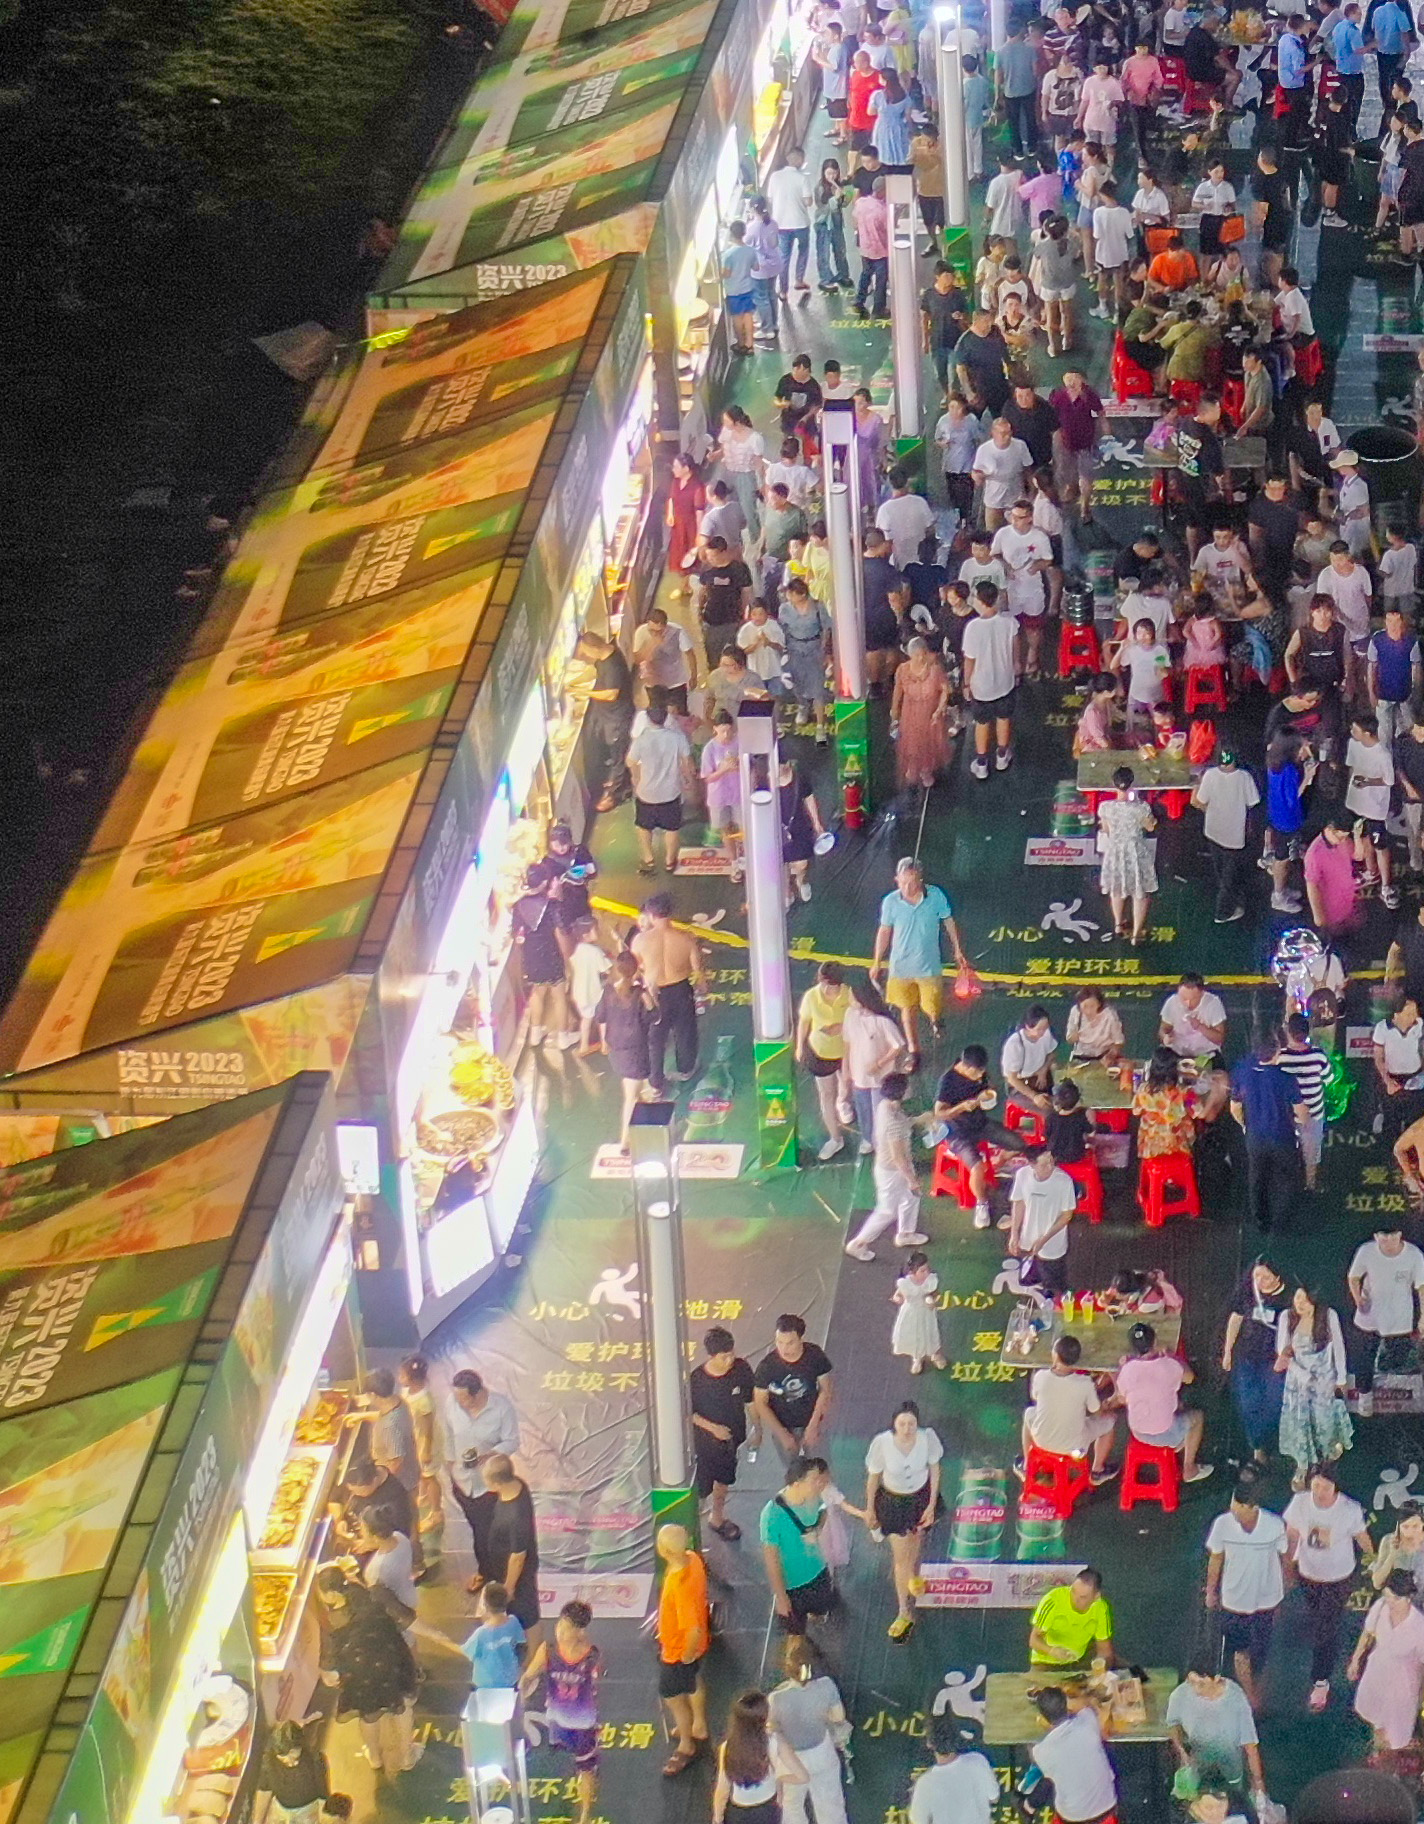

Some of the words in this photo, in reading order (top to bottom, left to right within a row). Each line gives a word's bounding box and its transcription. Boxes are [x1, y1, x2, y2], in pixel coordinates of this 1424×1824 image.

[1025, 957, 1141, 975] 爱护环境
[118, 1050, 183, 1084] 资兴
[186, 1051, 245, 1073] 2023
[12, 1265, 101, 1351] 资兴
[529, 1301, 590, 1321] 小心
[934, 1290, 994, 1310] 小心
[4, 1338, 69, 1408] 2023
[929, 1581, 989, 1592] TSINGTAO
[862, 1711, 927, 1738] 小心
